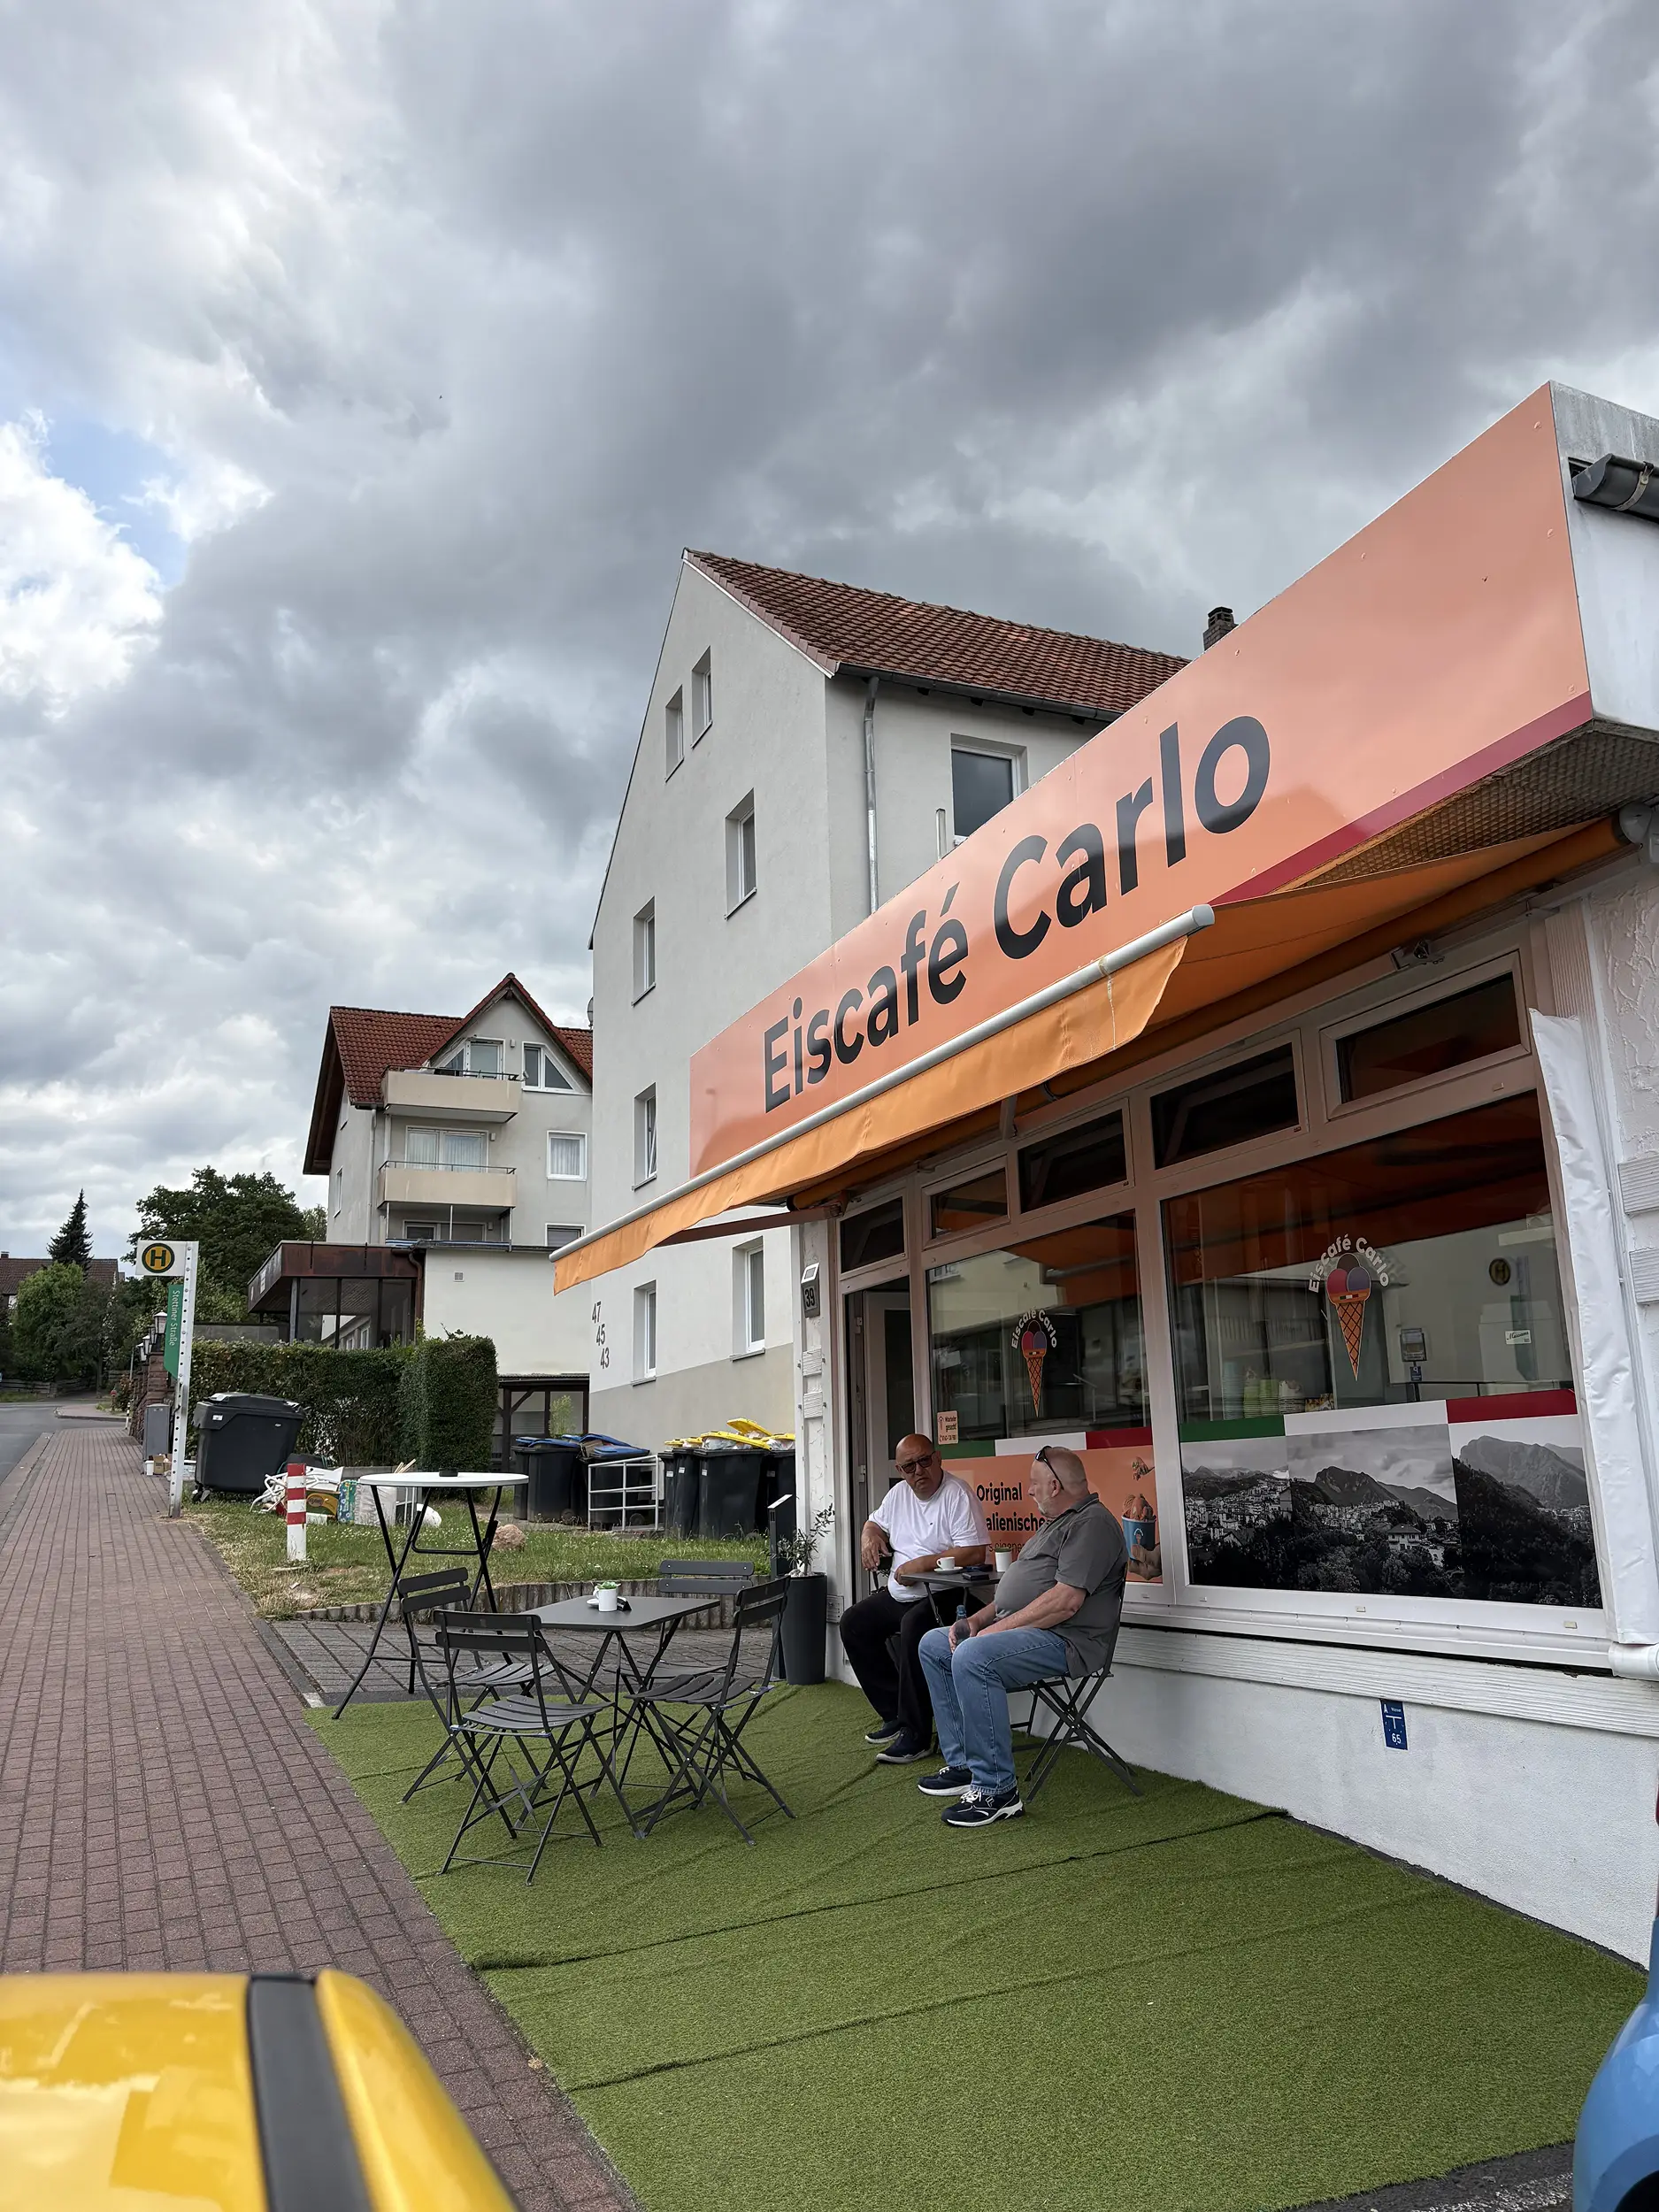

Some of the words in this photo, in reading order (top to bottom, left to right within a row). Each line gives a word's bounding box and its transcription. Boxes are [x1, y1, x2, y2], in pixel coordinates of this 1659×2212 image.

[764, 882, 969, 1113] Eiscafé
[994, 716, 1271, 960] Carlo
[150, 1249, 167, 1267] H
[1309, 1233, 1351, 1293] Eiscafé
[1356, 1237, 1389, 1286] Carlo
[170, 1290, 180, 1321] Stettiner
[804, 1287, 815, 1308] 39
[591, 1301, 602, 1324] 47
[169, 1323, 179, 1346] Straße
[595, 1324, 606, 1346] 45
[1038, 1309, 1057, 1348] Carlo
[600, 1347, 610, 1370] 43
[976, 1482, 1023, 1505] Original
[986, 1511, 1053, 1532] alienische
[1391, 1732, 1402, 1744] 65
